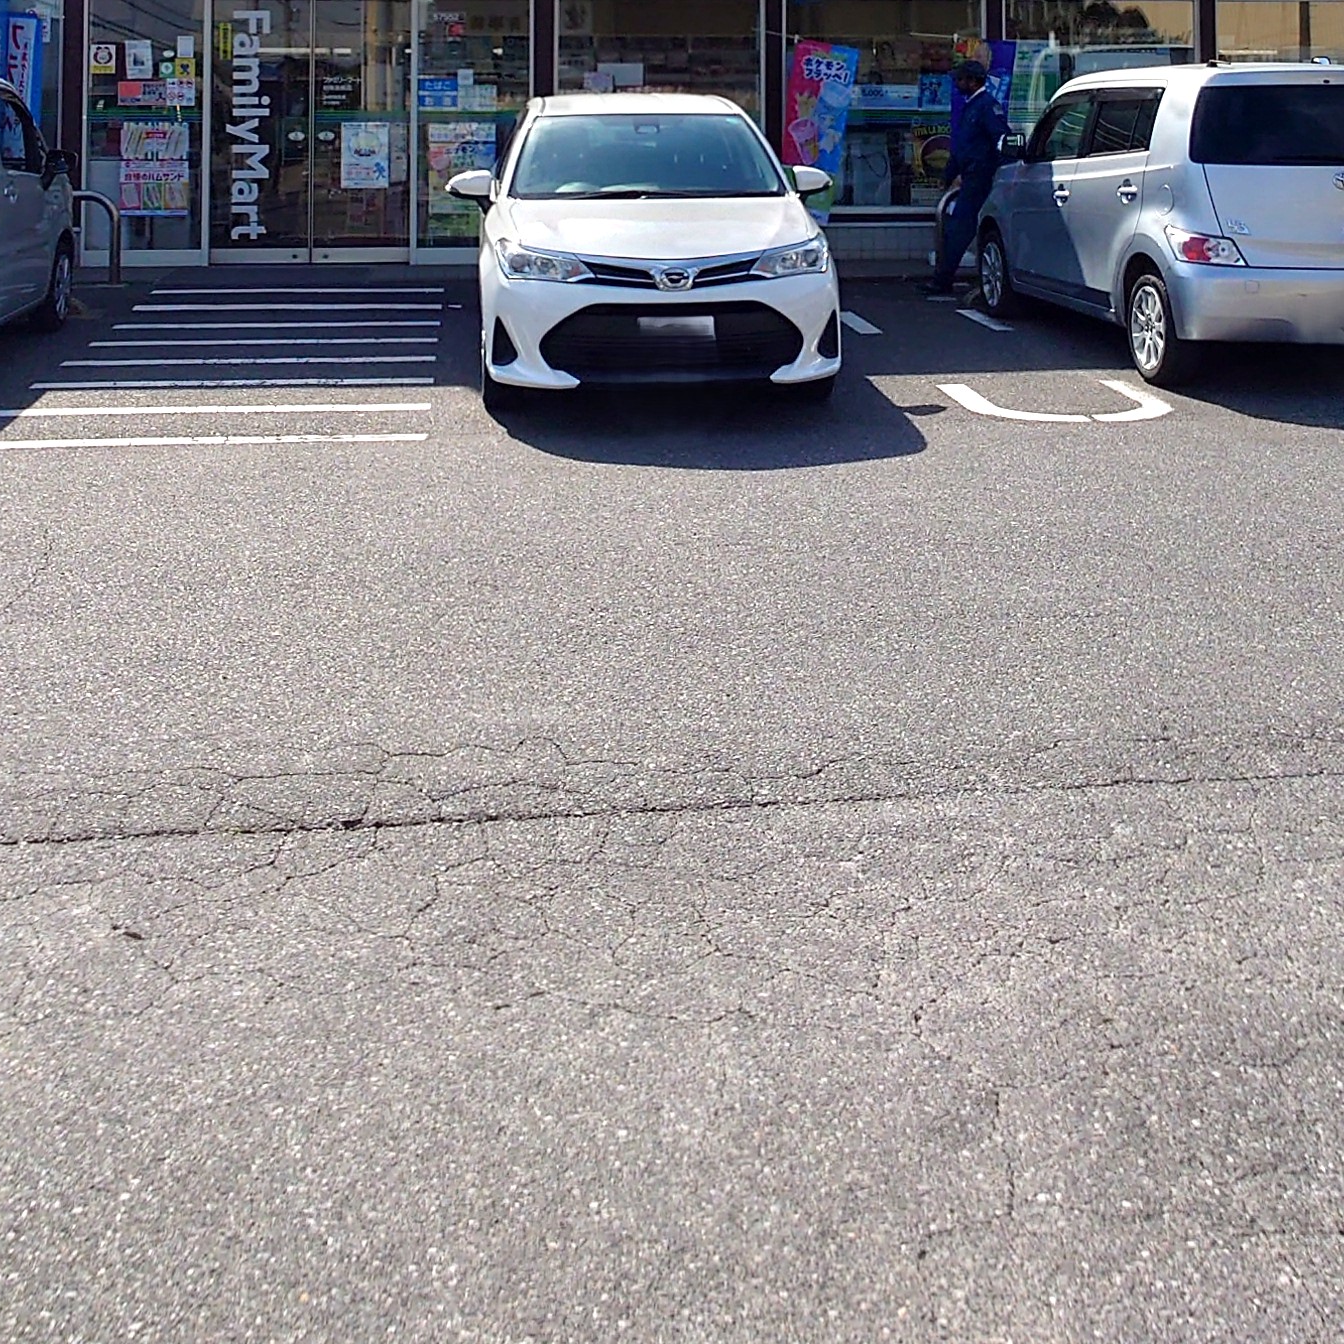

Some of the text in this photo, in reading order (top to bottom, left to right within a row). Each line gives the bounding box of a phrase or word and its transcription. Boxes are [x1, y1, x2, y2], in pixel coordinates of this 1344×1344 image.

[225, 10, 271, 240] FamilyMart
[803, 57, 845, 71] ポケモン
